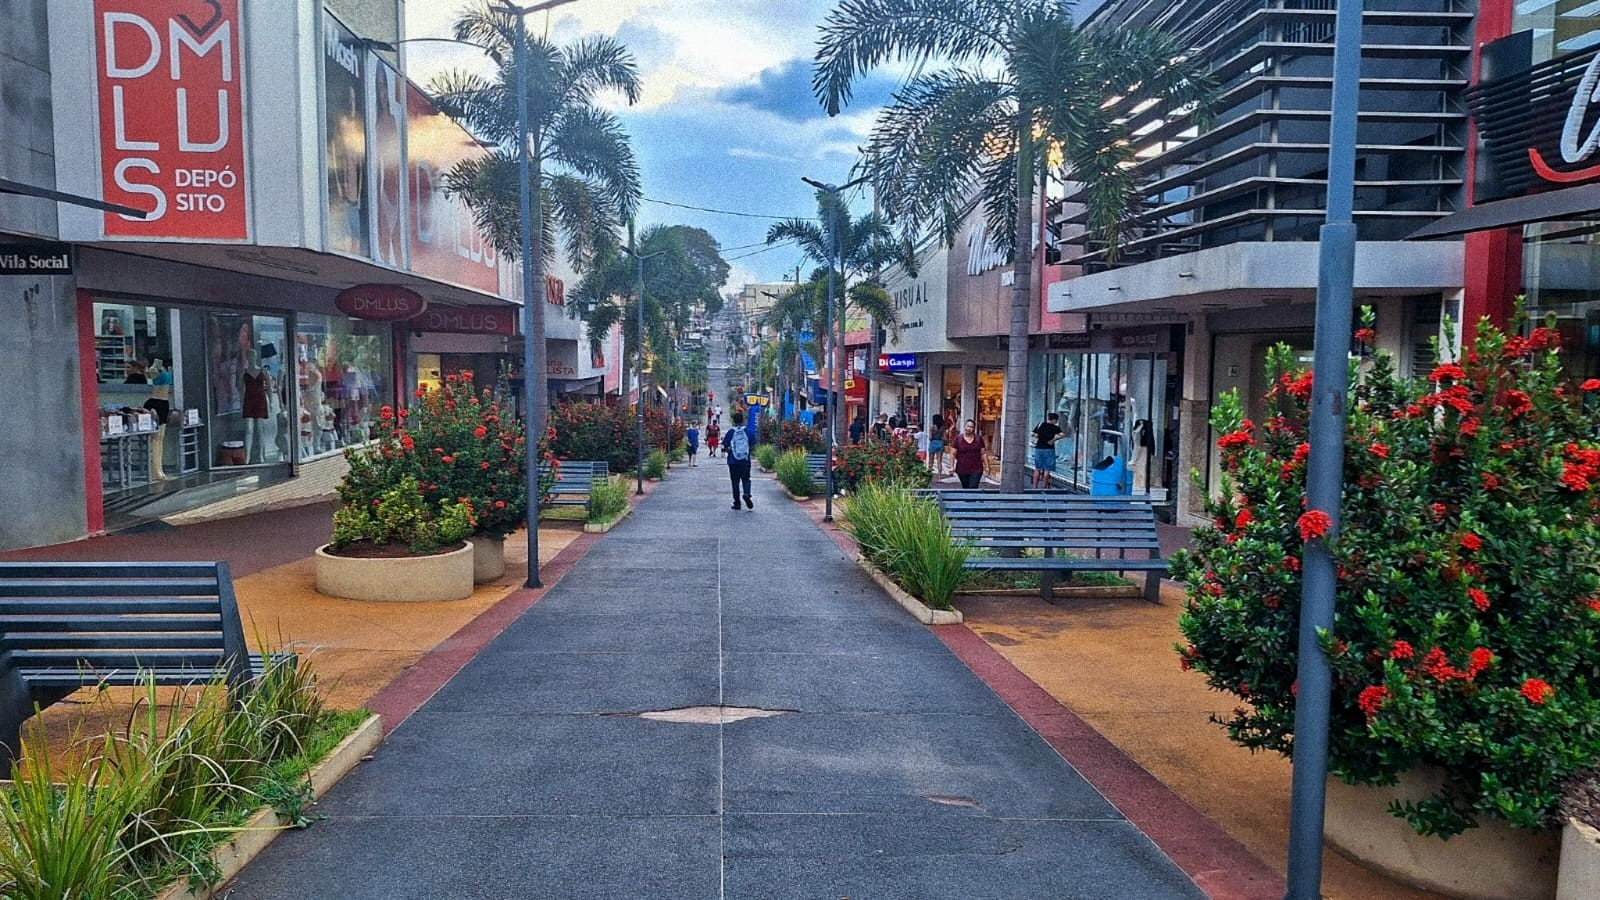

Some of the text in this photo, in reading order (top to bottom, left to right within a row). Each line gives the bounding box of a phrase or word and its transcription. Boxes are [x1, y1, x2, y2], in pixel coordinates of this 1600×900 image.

[103, 12, 233, 82] DM
[112, 85, 230, 153] LU
[175, 165, 237, 188] DEPÓ
[113, 157, 168, 222] S
[175, 193, 226, 213] SITO
[0, 254, 70, 269] Vila Social
[353, 295, 409, 311] DMLUS
[429, 312, 498, 331] DMLUS
[546, 366, 575, 376] LISTA
[889, 358, 915, 368] Gaspi
